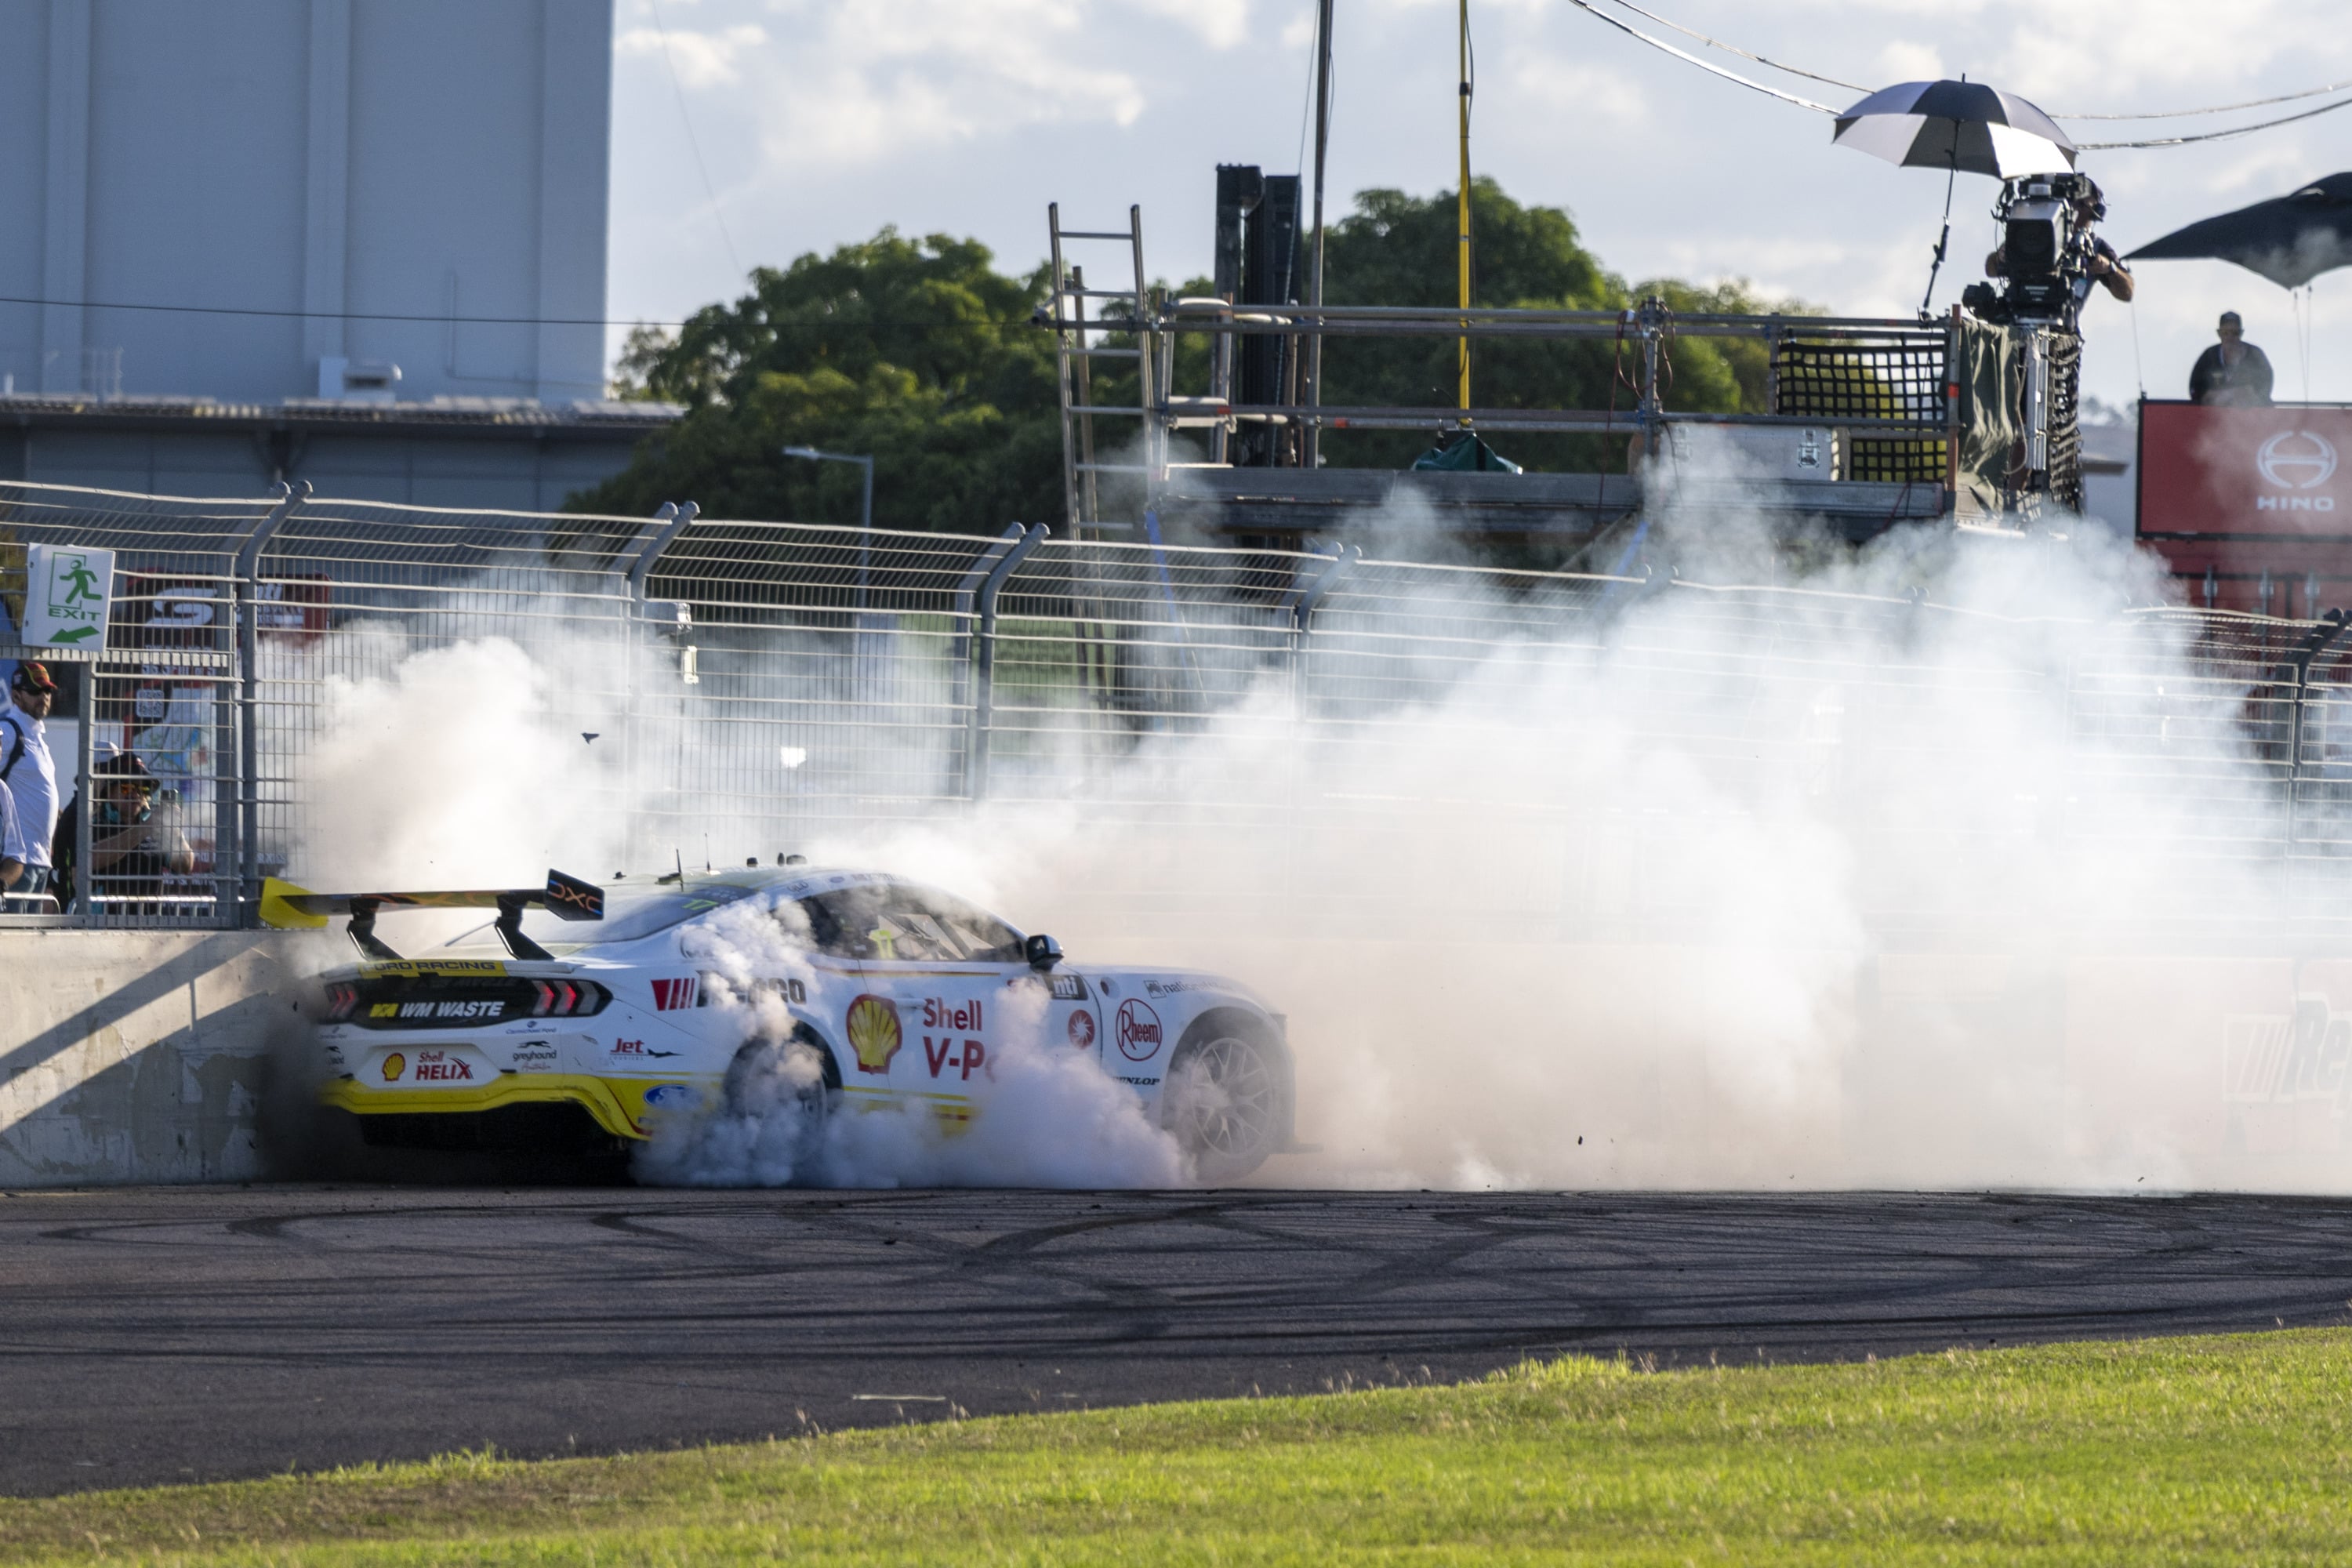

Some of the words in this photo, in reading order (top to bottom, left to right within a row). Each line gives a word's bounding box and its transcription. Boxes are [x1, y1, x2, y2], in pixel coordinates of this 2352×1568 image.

[2257, 496, 2335, 511] HINO
[49, 608, 101, 621] EXIT
[415, 961, 496, 971] RACING
[1054, 976, 1079, 995] nti
[400, 1002, 434, 1018] WM
[437, 1001, 505, 1017] WASTE
[923, 996, 982, 1032] Shell
[1120, 1001, 1159, 1050] Rheem
[610, 1038, 644, 1054] Jet
[419, 1051, 444, 1064] Shell
[514, 1050, 557, 1062] greyhound
[416, 1058, 474, 1080] HELIX
